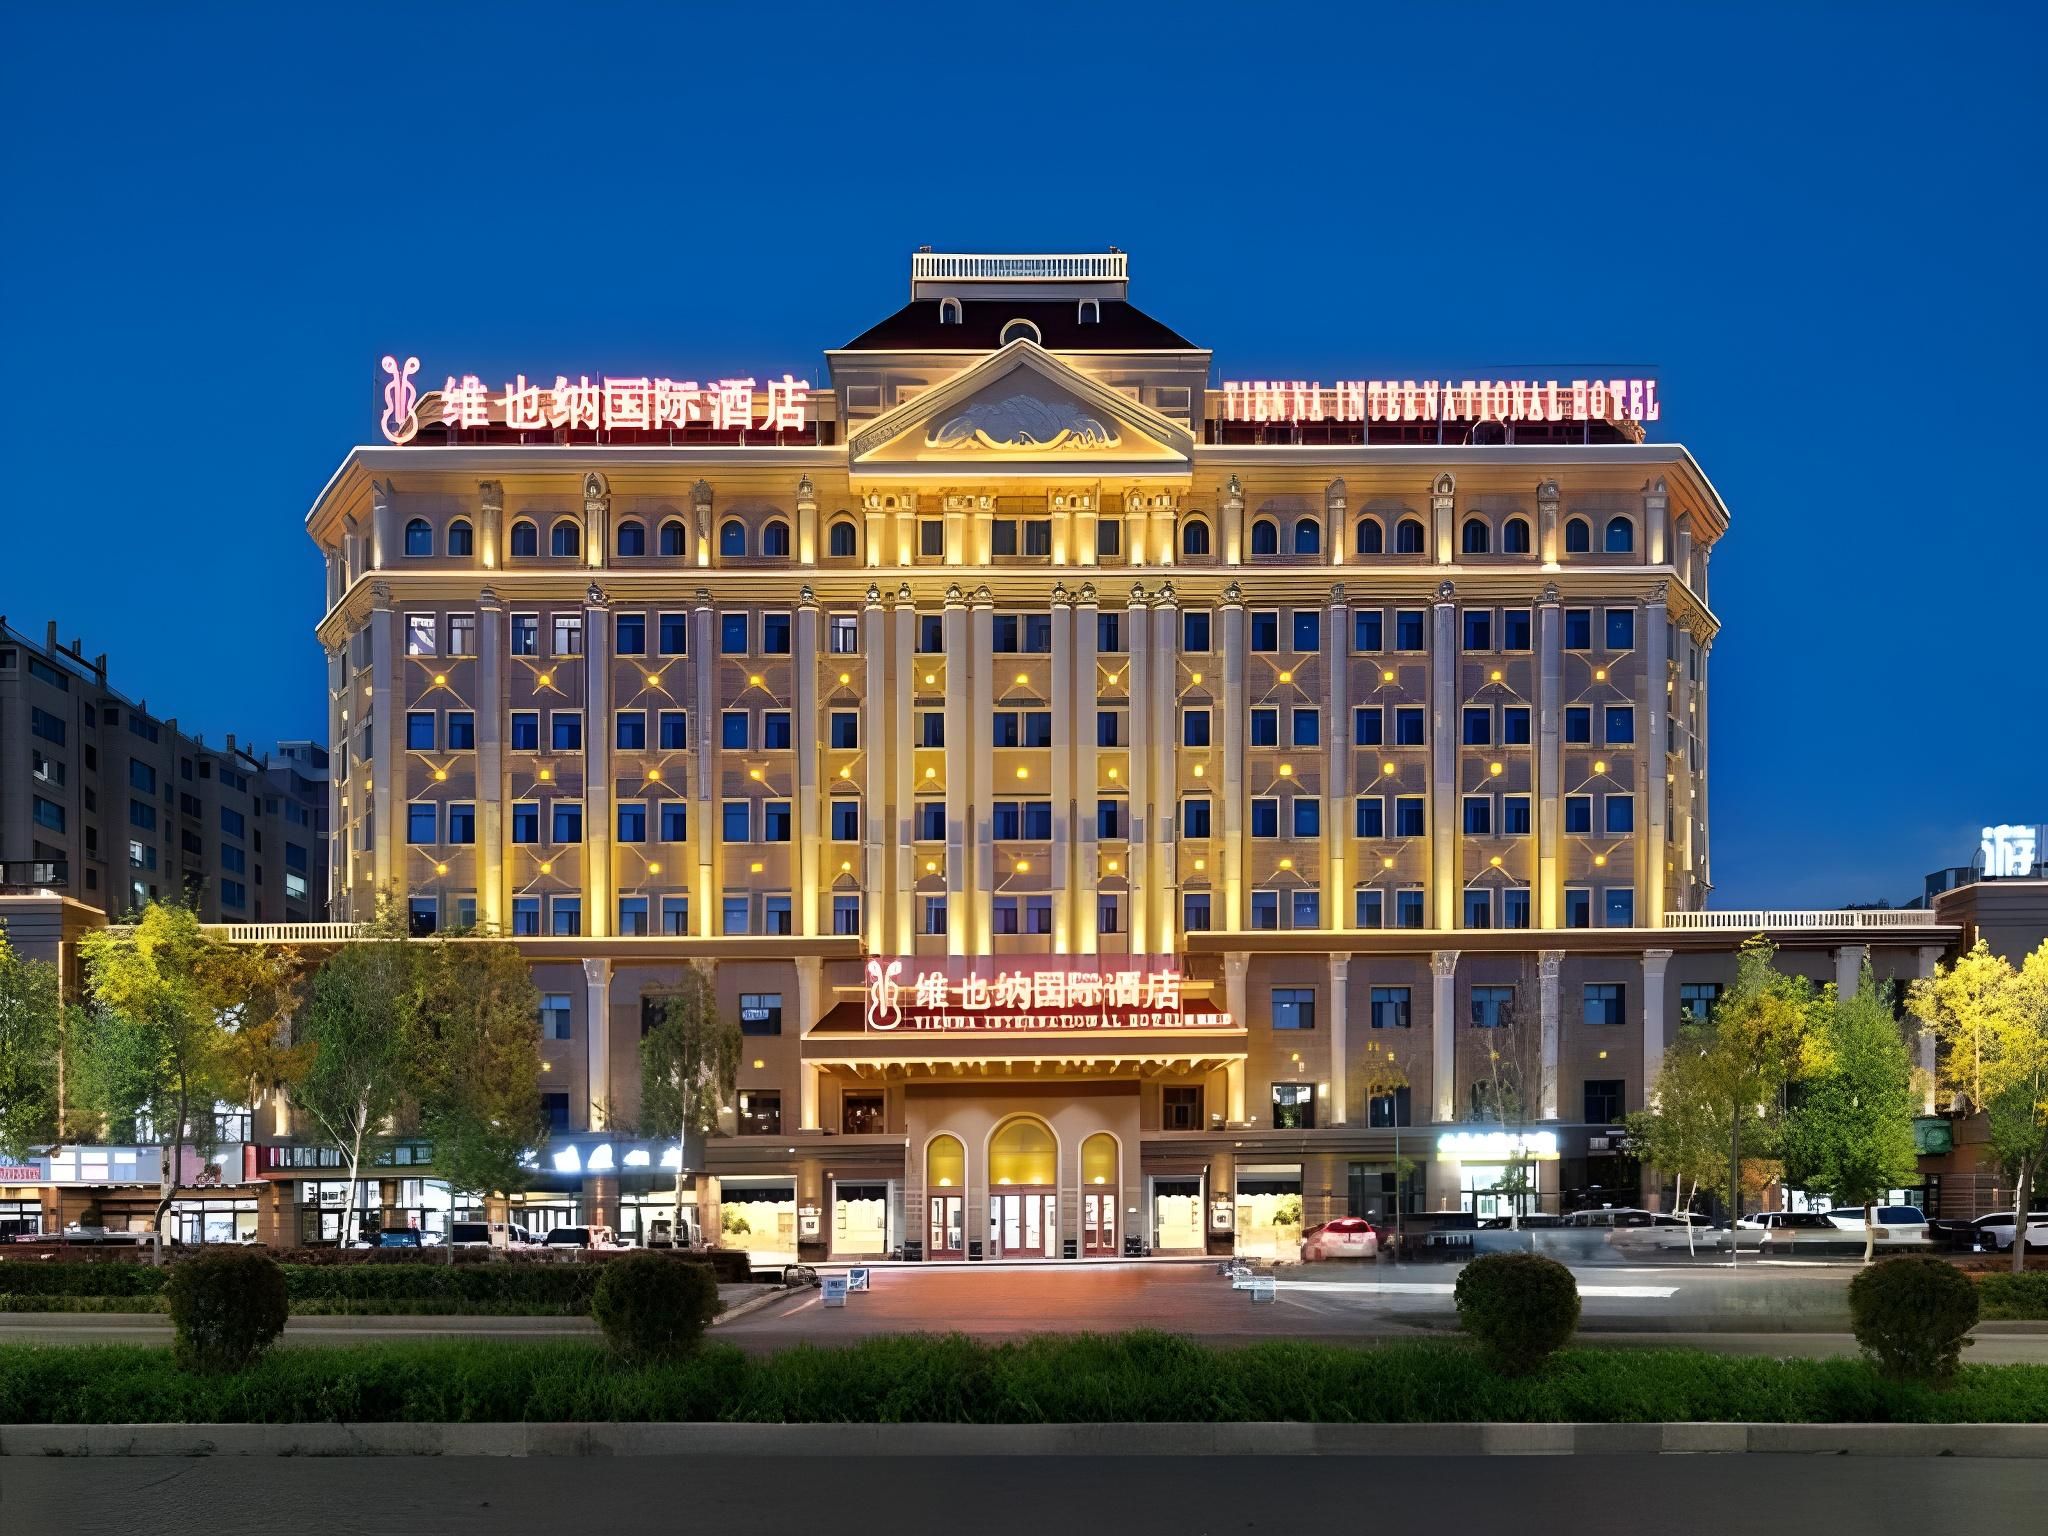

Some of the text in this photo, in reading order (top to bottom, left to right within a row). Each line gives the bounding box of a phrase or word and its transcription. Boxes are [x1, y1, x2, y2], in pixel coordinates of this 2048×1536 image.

[442, 374, 810, 432] 维也纳国际酒店
[914, 969, 1182, 1010] 维也纳国际酒店
